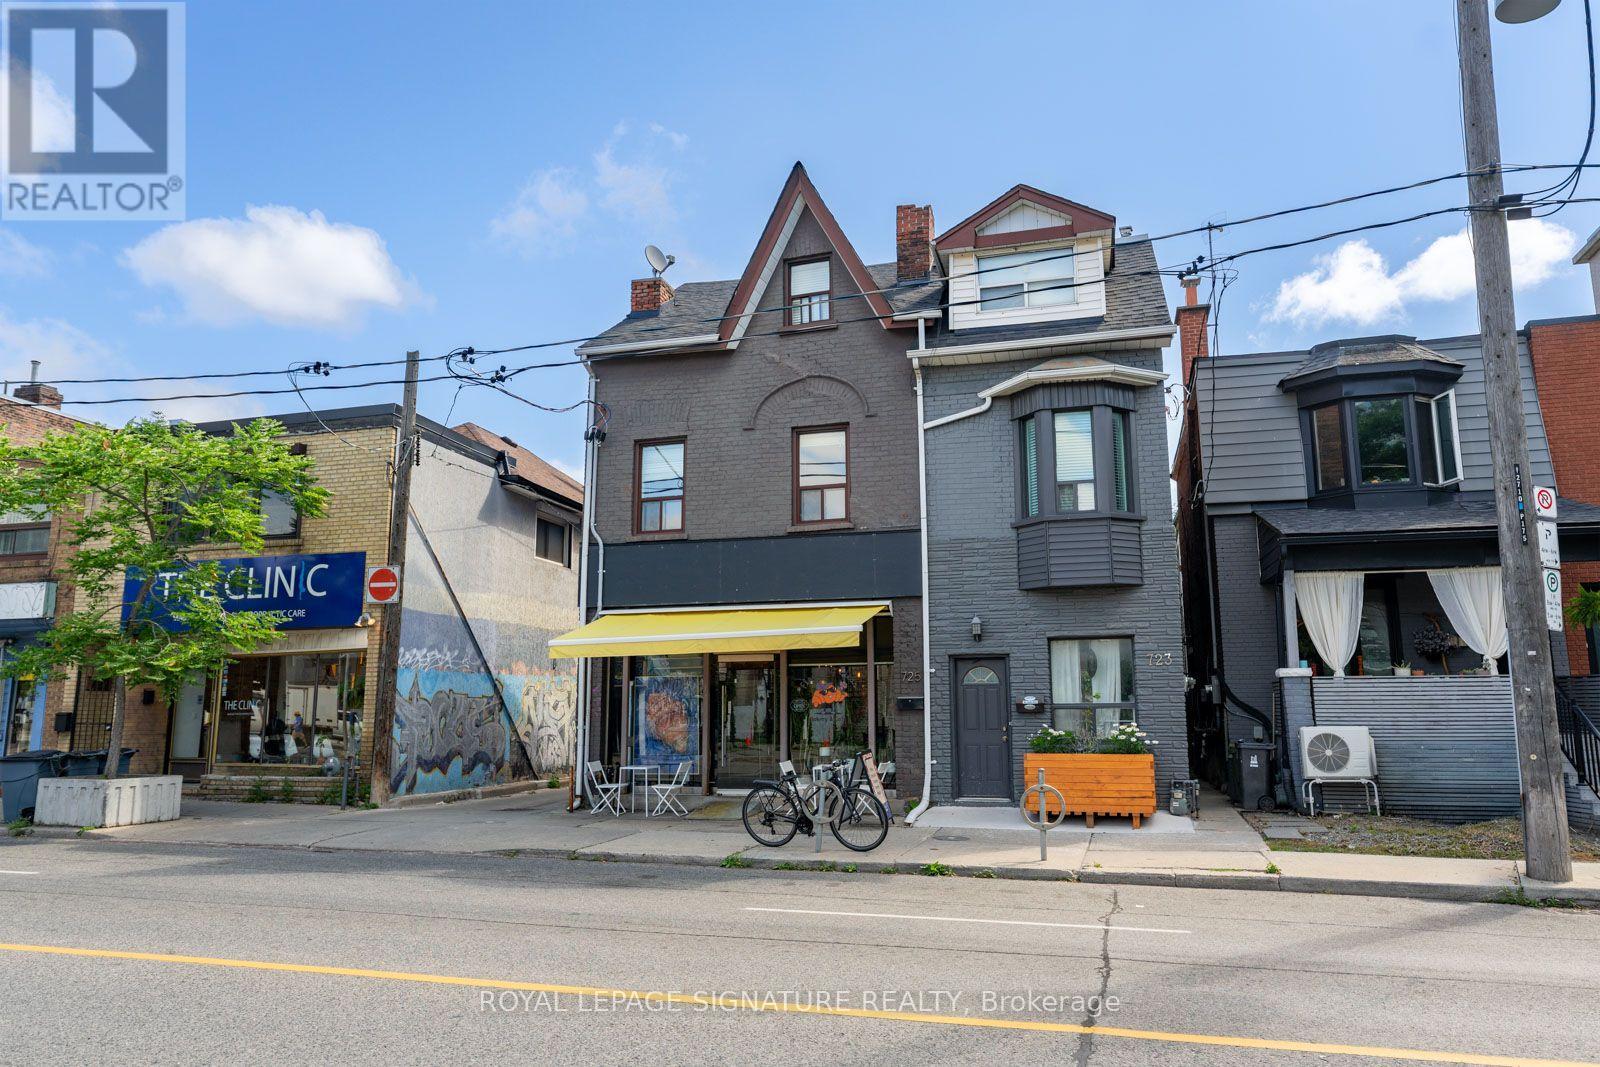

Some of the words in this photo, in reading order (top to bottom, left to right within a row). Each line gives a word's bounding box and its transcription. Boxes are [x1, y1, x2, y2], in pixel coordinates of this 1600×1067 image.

[288, 609, 306, 618] CARE
[1145, 653, 1173, 666] 723
[901, 671, 921, 682] 725
[224, 700, 237, 710] THE
